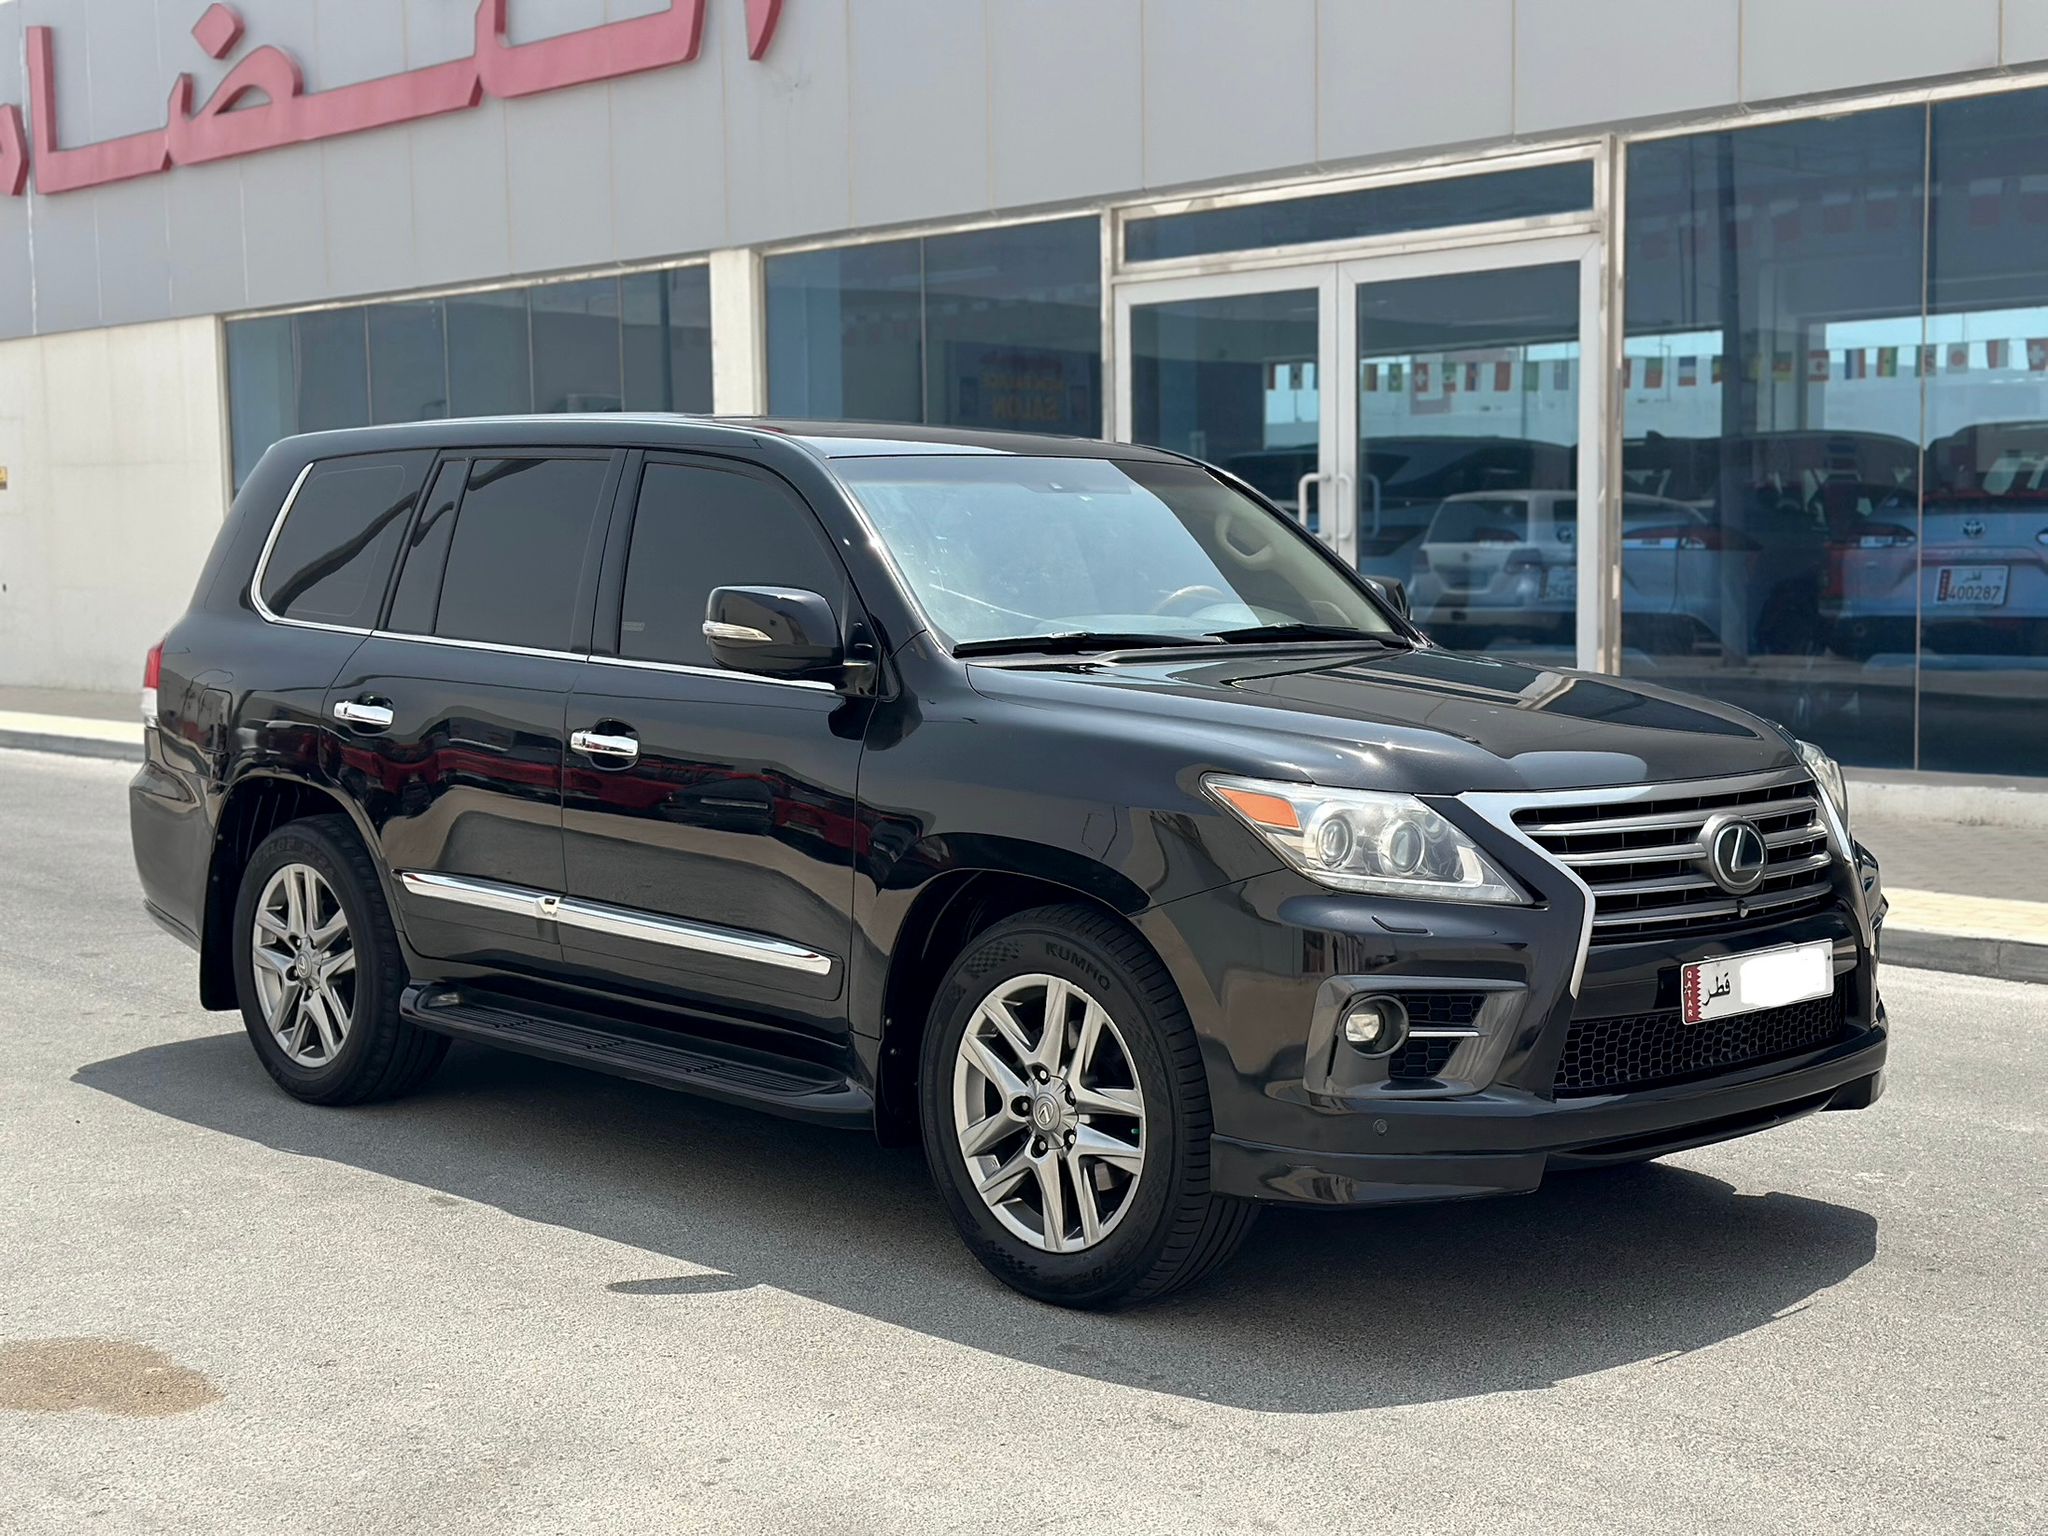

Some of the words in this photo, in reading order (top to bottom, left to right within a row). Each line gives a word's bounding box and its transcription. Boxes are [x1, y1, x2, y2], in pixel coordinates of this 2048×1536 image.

[1948, 585, 2001, 600] 400287
[1045, 942, 1111, 991] KUMHO
[1686, 970, 1694, 1017] QATAR
[1702, 972, 1731, 1006] قطر
